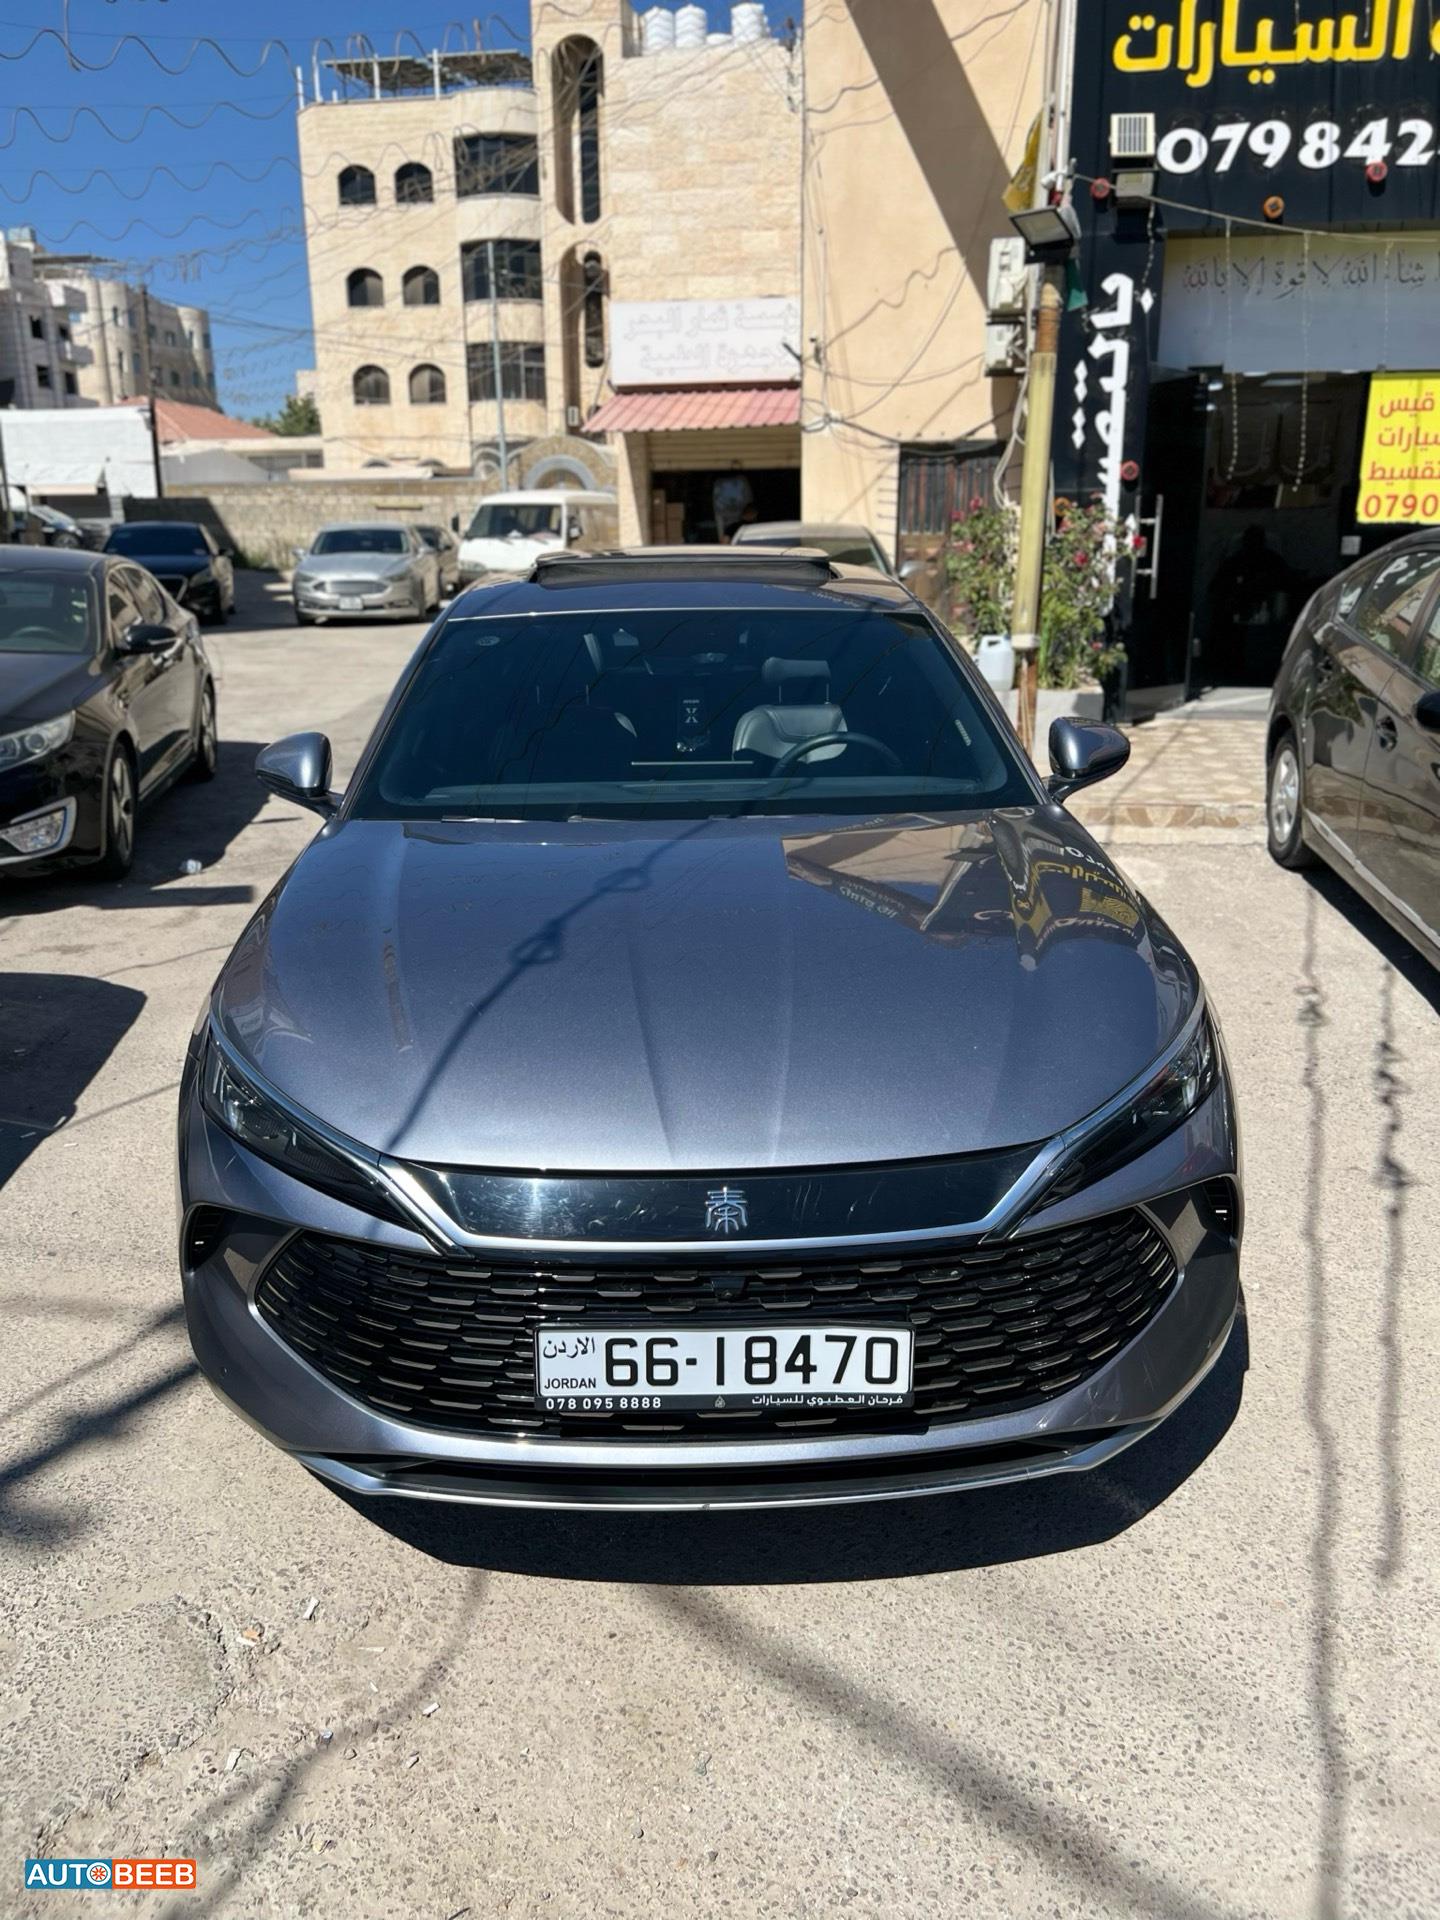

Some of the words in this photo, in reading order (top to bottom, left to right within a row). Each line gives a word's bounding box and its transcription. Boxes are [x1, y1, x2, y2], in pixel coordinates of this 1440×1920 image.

[1157, 118, 1440, 174] 079842
[1379, 391, 1434, 418] قيس
[542, 1335, 596, 1359] الاردن
[605, 1334, 899, 1387] 66-18470
[544, 1377, 597, 1390] JORDAN
[545, 1397, 577, 1410] 078
[582, 1397, 614, 1410] 095
[619, 1396, 662, 1409] 8888
[751, 1394, 804, 1407] للسيارات
[867, 1394, 904, 1406] فرحان
